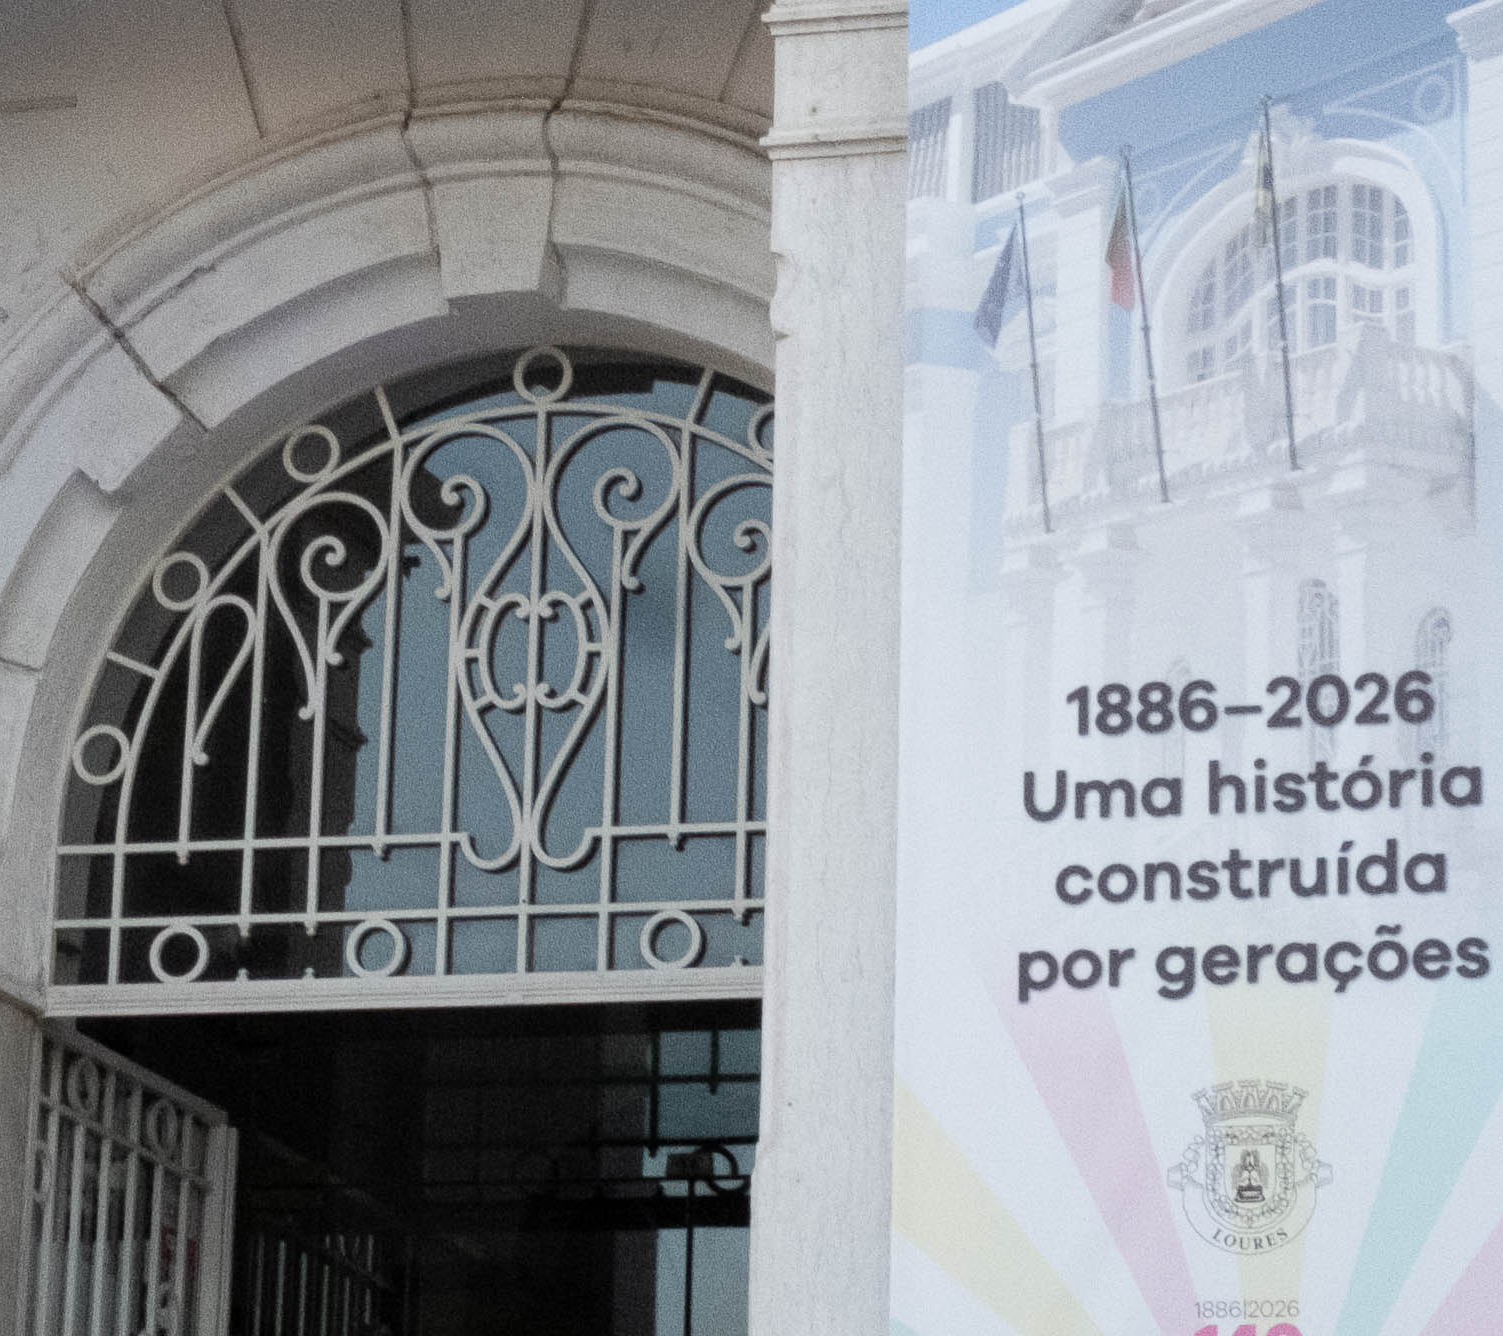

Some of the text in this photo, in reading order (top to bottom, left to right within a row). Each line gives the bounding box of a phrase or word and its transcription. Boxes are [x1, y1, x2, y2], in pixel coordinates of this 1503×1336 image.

[1022, 751, 1485, 823] Uma história
[1054, 838, 1448, 906] construída
[1017, 924, 1493, 1004] por gerações
[1212, 1228, 1289, 1251] LOURES
